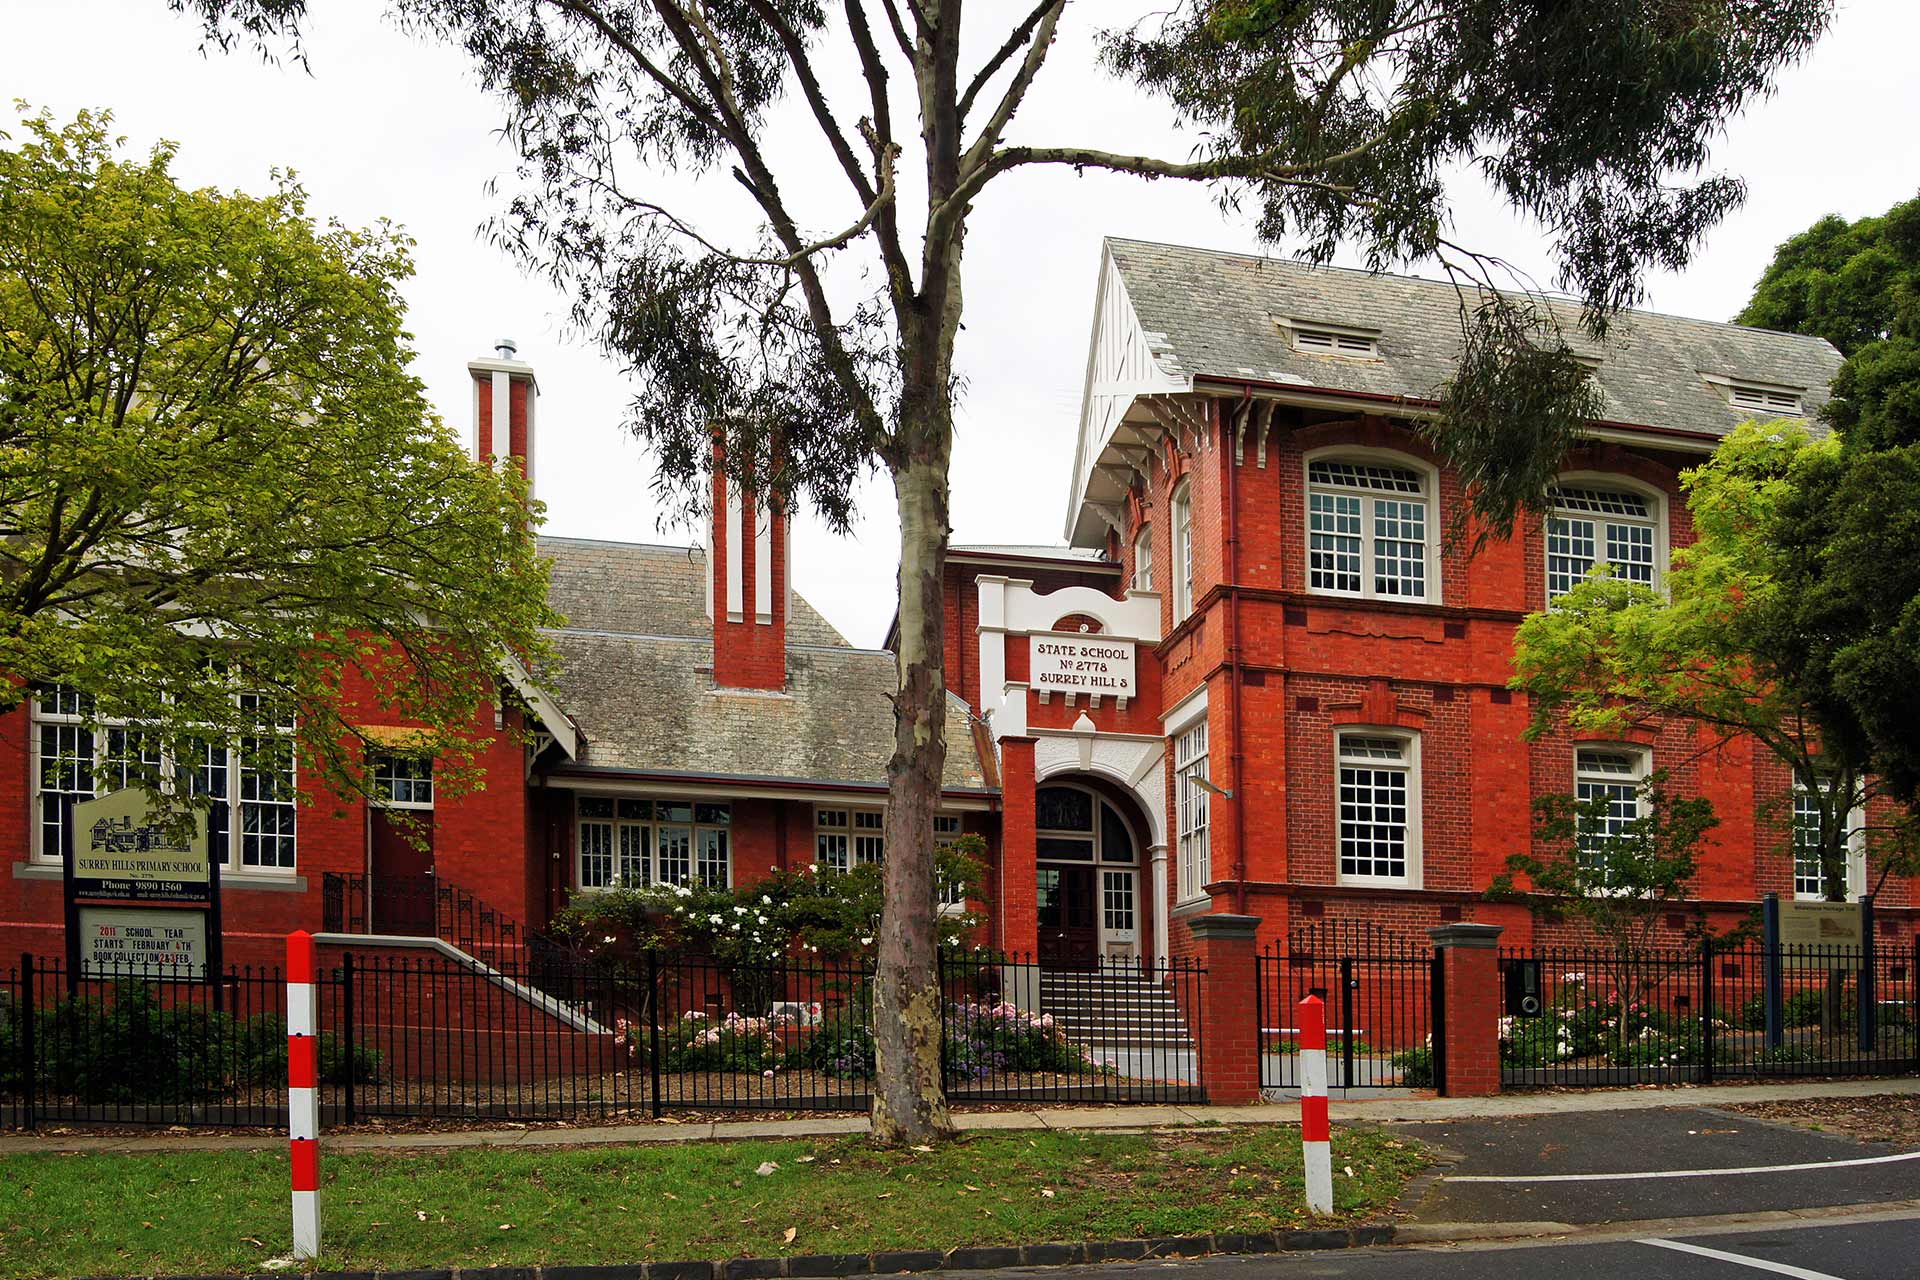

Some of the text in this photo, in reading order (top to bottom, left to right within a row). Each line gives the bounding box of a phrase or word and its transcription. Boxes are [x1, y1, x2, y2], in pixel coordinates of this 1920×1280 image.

[1038, 644, 1129, 660] STATE SCHOOL
[1076, 661, 1108, 672] 2778
[1040, 672, 1128, 688] SURREY HILLS
[79, 859, 203, 873] SURREY HILLS PRIMARY SCHOOL
[102, 880, 182, 892] Phone 9890 1560
[100, 926, 184, 938] 2011 SCHOOL YEAR
[94, 939, 123, 949] STARTS
[133, 940, 169, 950] FEBRUARY
[94, 952, 112, 961] BOOK
[114, 952, 159, 962] COLLECTION
